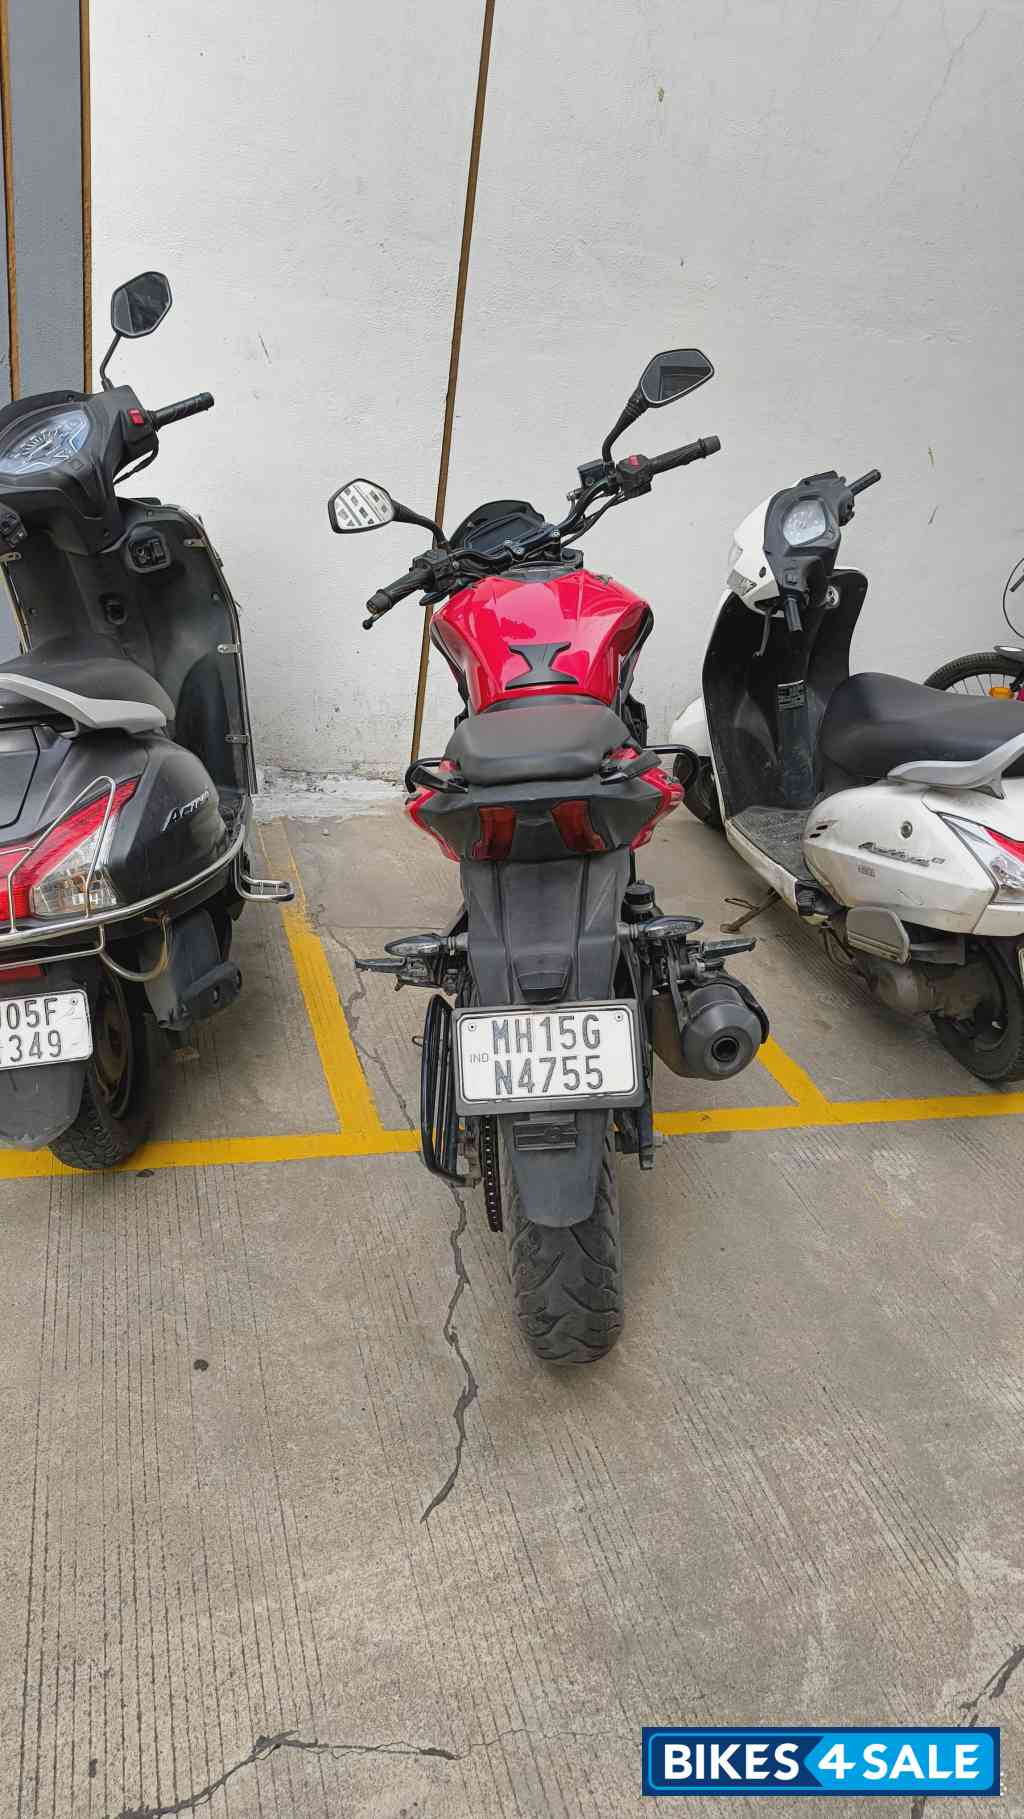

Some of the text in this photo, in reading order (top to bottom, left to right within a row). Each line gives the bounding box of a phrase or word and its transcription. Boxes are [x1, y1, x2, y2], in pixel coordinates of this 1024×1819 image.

[0, 997, 58, 1030] 05F
[0, 1029, 62, 1064] 349
[492, 1014, 601, 1055] MH15G
[469, 1052, 489, 1063] IND
[495, 1054, 603, 1095] N4755
